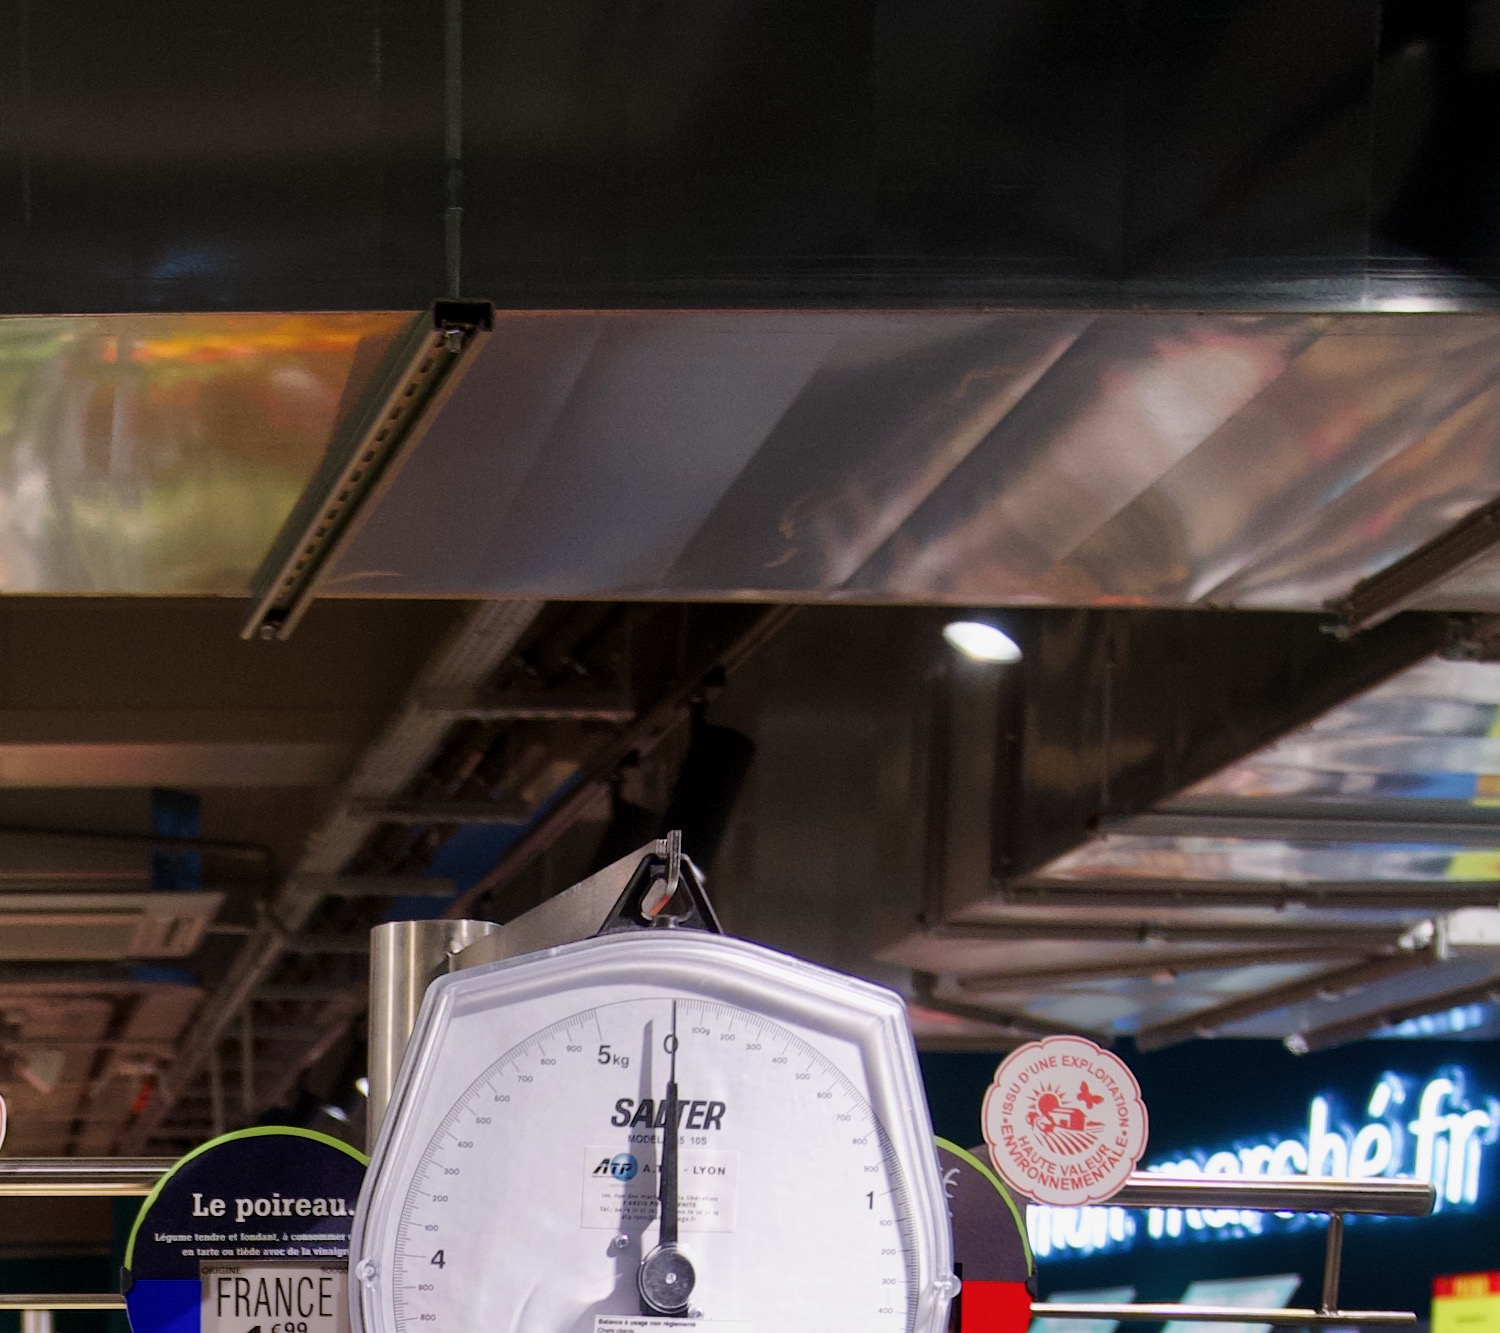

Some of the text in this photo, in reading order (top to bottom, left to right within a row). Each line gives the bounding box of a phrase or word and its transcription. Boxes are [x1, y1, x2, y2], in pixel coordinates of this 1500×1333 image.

[691, 1027, 710, 1036] 100g
[517, 1075, 533, 1083] 700
[1002, 1055, 1130, 1127] ISSU D'UNE EXPLOITATION
[1001, 1124, 1129, 1191] ENVIRONNEMENTALE
[1018, 1135, 1110, 1177] HAUTE VALEUR
[693, 1166, 726, 1175] LYON
[192, 1193, 226, 1217] Le
[866, 1191, 874, 1210] 1
[154, 1233, 192, 1244] Légume
[194, 1233, 226, 1241] tendre
[282, 1232, 288, 1241] à
[291, 1233, 346, 1241] consommer
[287, 1248, 299, 1256] de
[301, 1247, 311, 1256] la
[430, 1249, 446, 1269] 4
[217, 1276, 333, 1318] FRANCE
